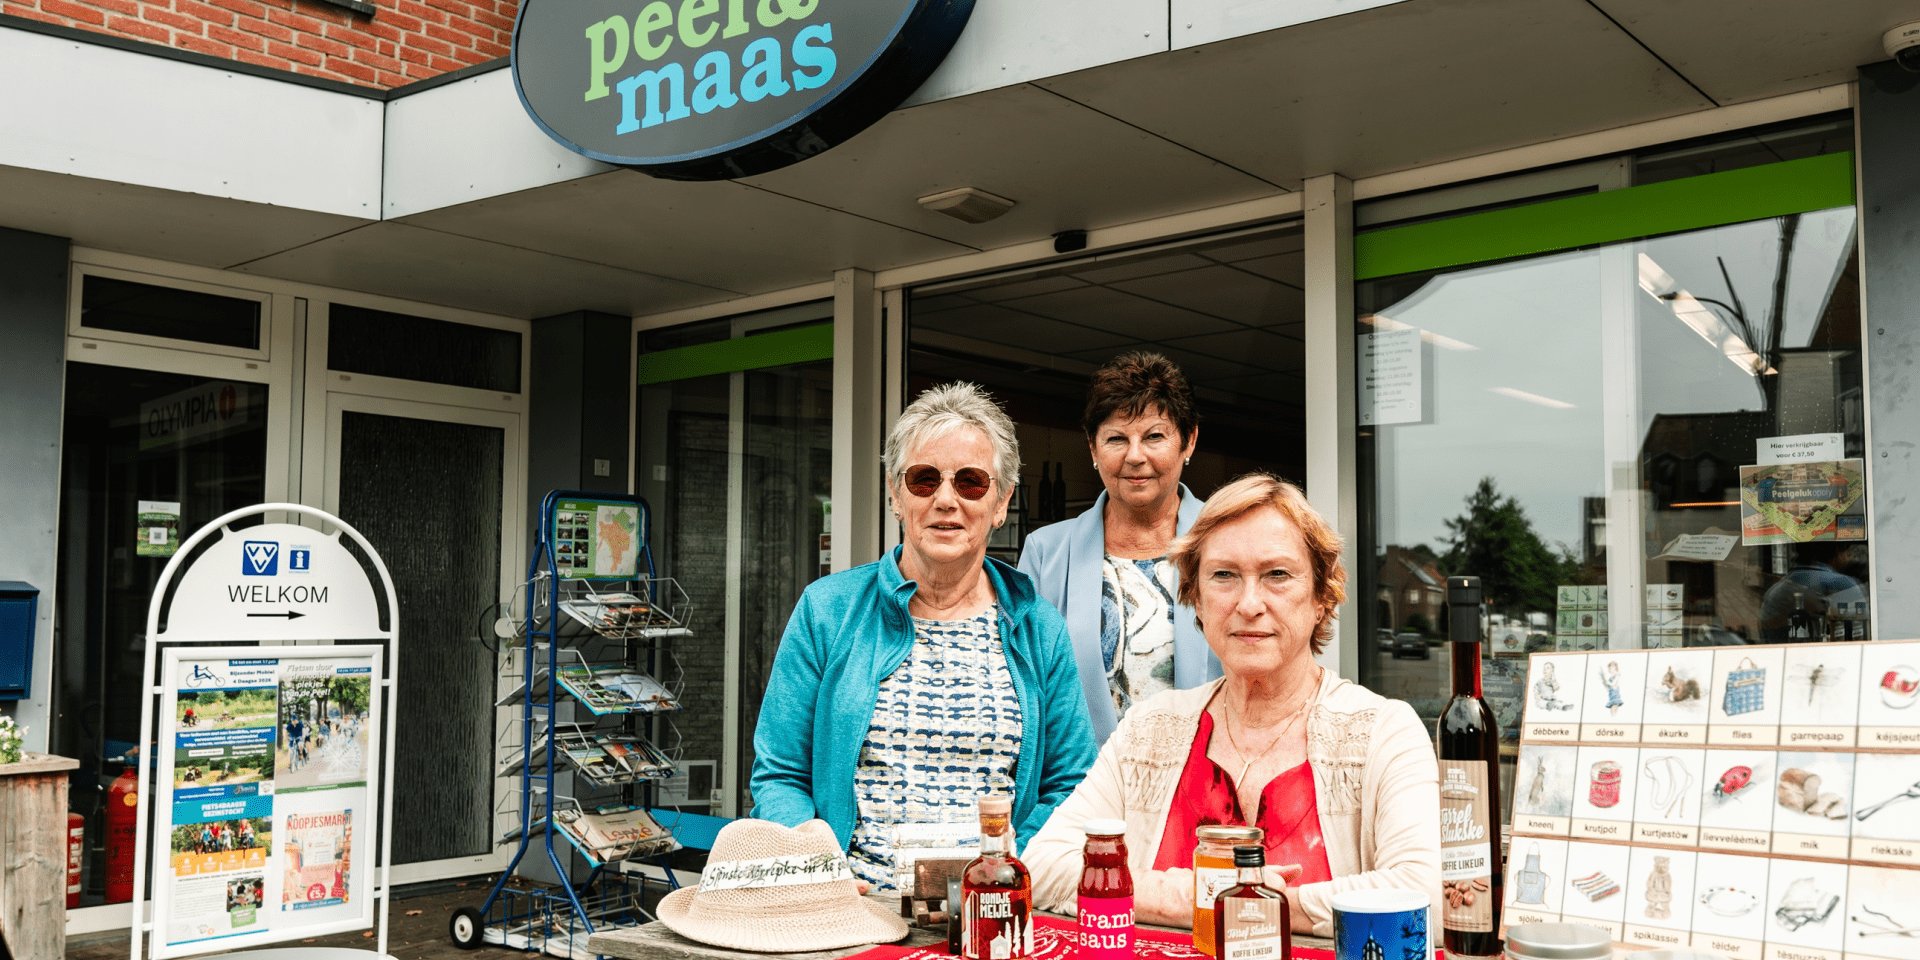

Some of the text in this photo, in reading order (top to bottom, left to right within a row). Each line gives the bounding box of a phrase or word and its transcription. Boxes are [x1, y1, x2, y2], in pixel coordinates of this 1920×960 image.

[616, 22, 837, 136] maas
[149, 392, 217, 437] OLYMPIA
[228, 585, 328, 603] WELKOM
[288, 664, 314, 672] Fietsen
[1732, 730, 1752, 739] flies
[1790, 732, 1844, 742] garrepaap
[202, 801, 246, 810] FIETS4DAAGSE
[203, 808, 245, 817] GEZINSTOCHT
[287, 813, 351, 830] KOOPJESMARKT
[600, 826, 653, 841] Lente
[1528, 820, 1554, 830] kneenj
[1800, 840, 1819, 849] mik
[1870, 846, 1913, 856] riekske
[804, 860, 816, 874] in
[1442, 858, 1484, 871] OFFIE LIKEUR
[980, 892, 1010, 904] RONDJE
[980, 904, 1013, 918] MEIJEL
[1080, 932, 1127, 949] saus
[1633, 930, 1679, 944] spiklassie
[1233, 949, 1251, 958] KOFFIE
[1252, 946, 1273, 956] LIKEUR
